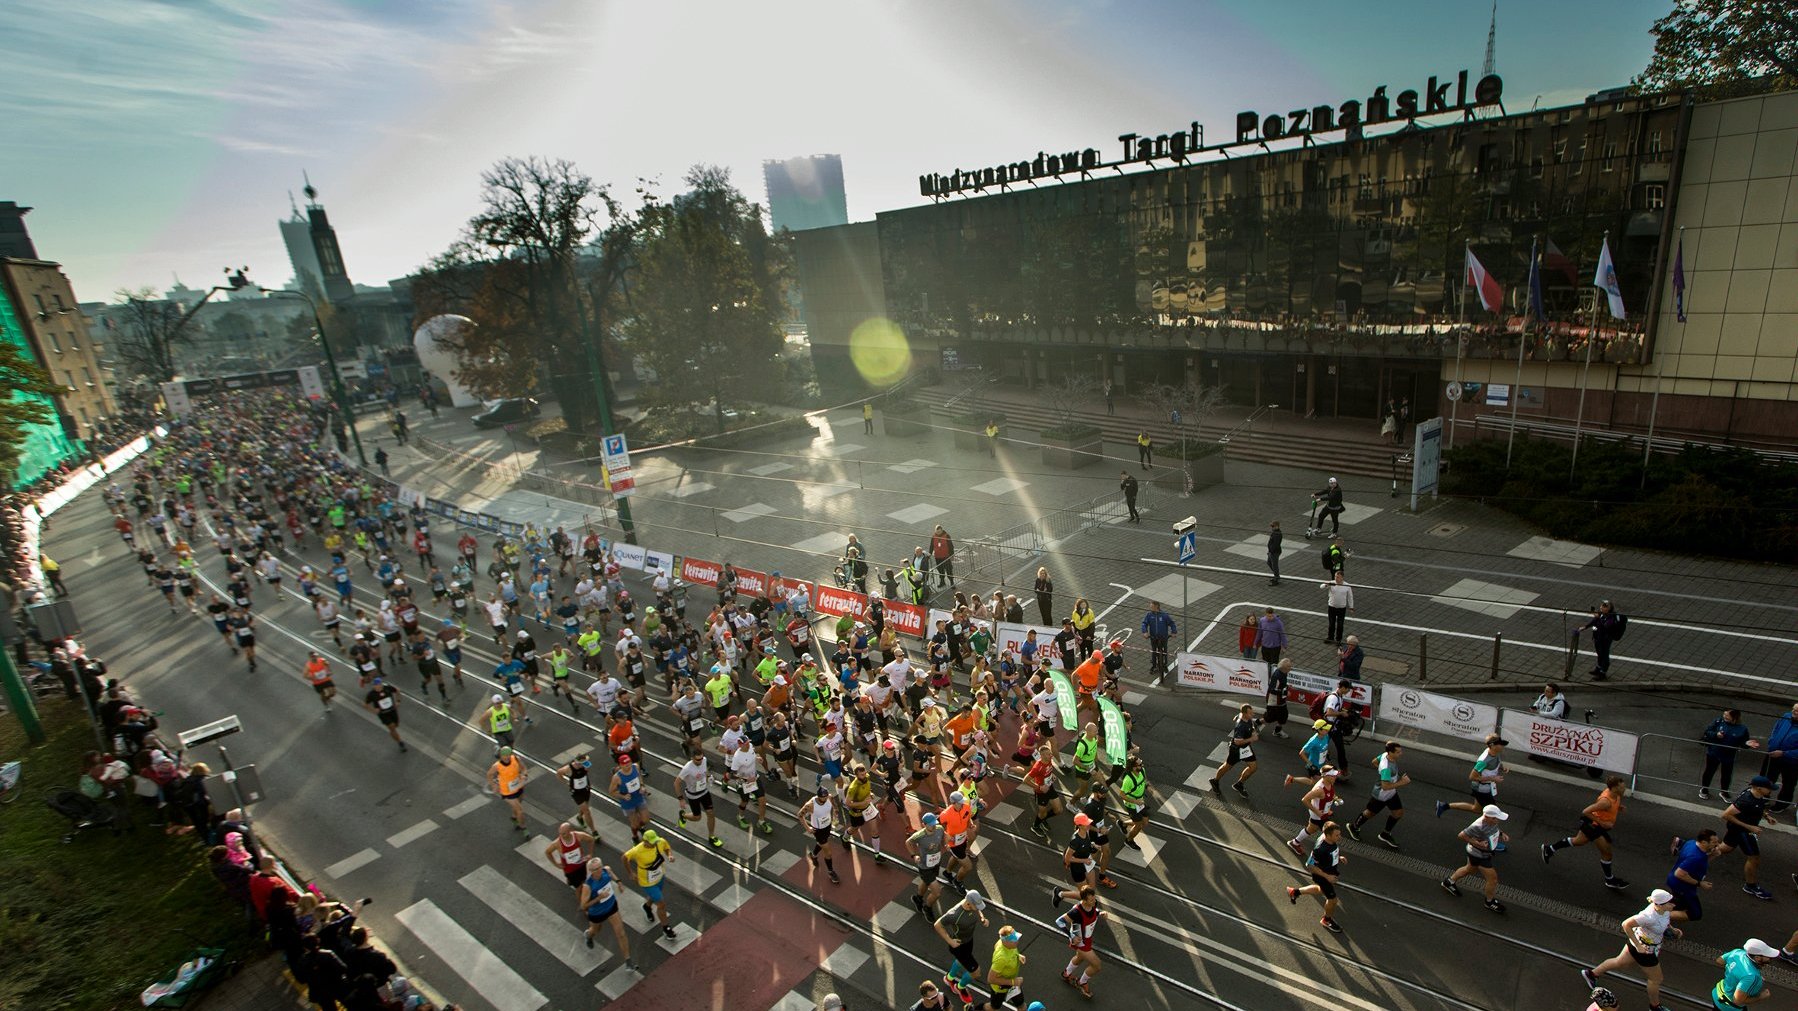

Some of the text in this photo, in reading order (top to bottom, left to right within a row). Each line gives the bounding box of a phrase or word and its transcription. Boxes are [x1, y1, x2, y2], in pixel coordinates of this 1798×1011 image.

[1118, 121, 1199, 163] Targi
[1236, 69, 1503, 143] Poznańskie
[684, 563, 719, 582] terravita
[738, 575, 762, 592] avita
[819, 591, 863, 616] terravita
[887, 608, 921, 629] ravita
[1184, 669, 1214, 678] MARATONY
[1229, 676, 1261, 685] MARATONY
[1530, 732, 1604, 756] SZPIKU
[1530, 744, 1597, 765] www.darszpiku.pl
